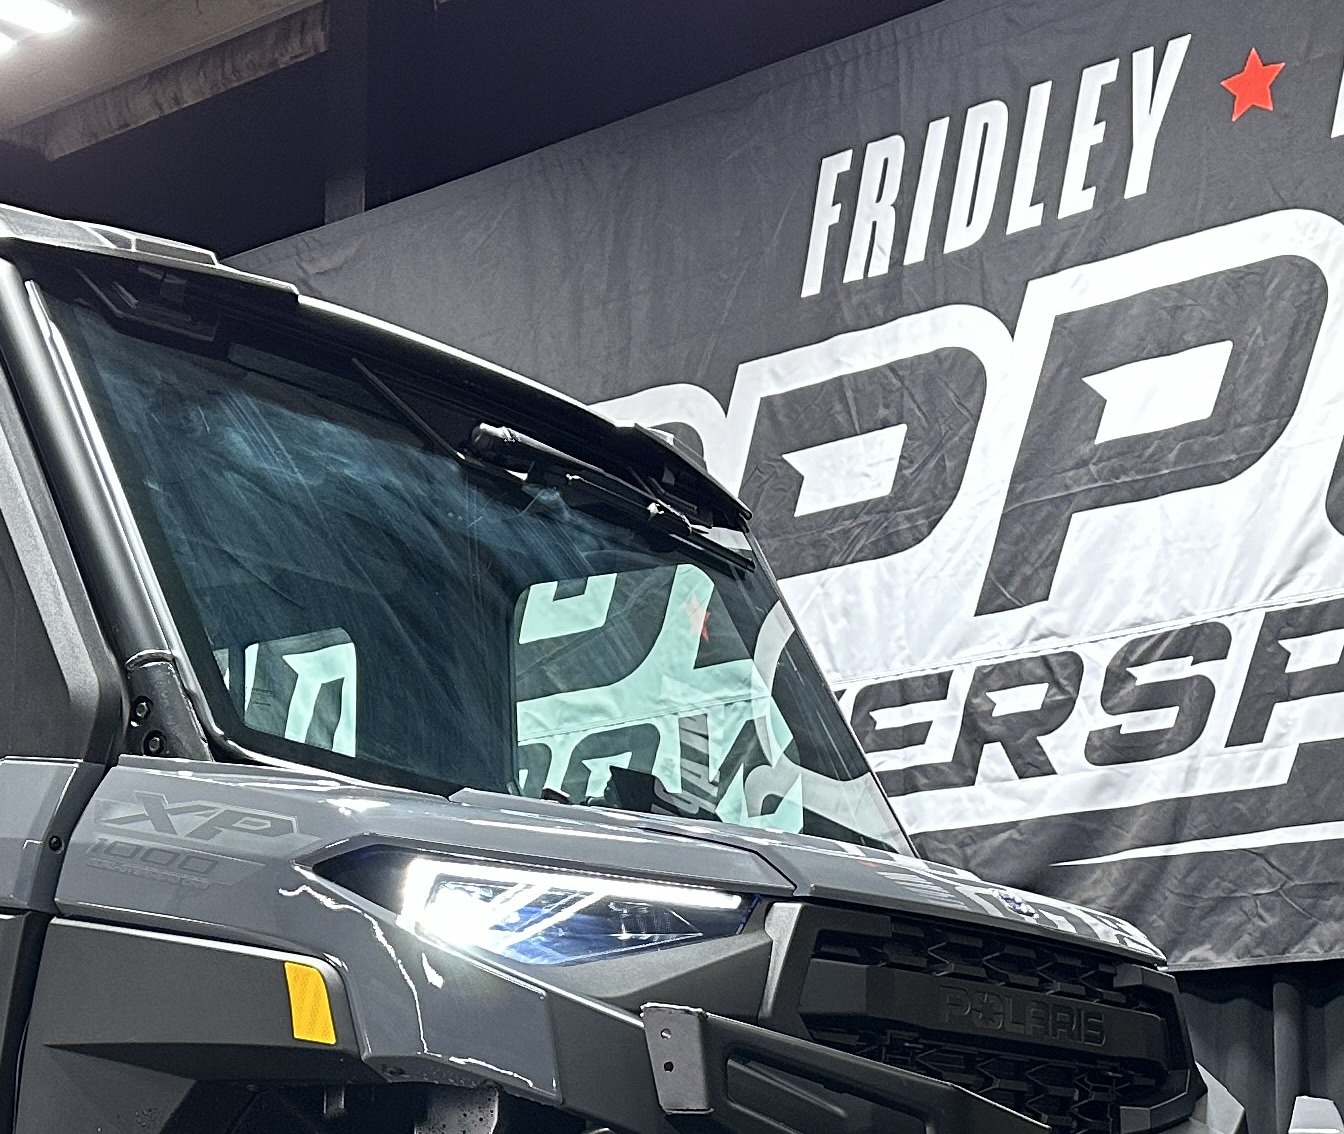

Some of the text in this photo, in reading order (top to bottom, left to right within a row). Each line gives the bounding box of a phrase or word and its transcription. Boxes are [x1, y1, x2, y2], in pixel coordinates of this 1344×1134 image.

[800, 33, 1192, 299] FRIDLEY
[107, 790, 300, 842] XP
[88, 836, 219, 875] 1000
[938, 984, 1109, 1048] POLARIS
